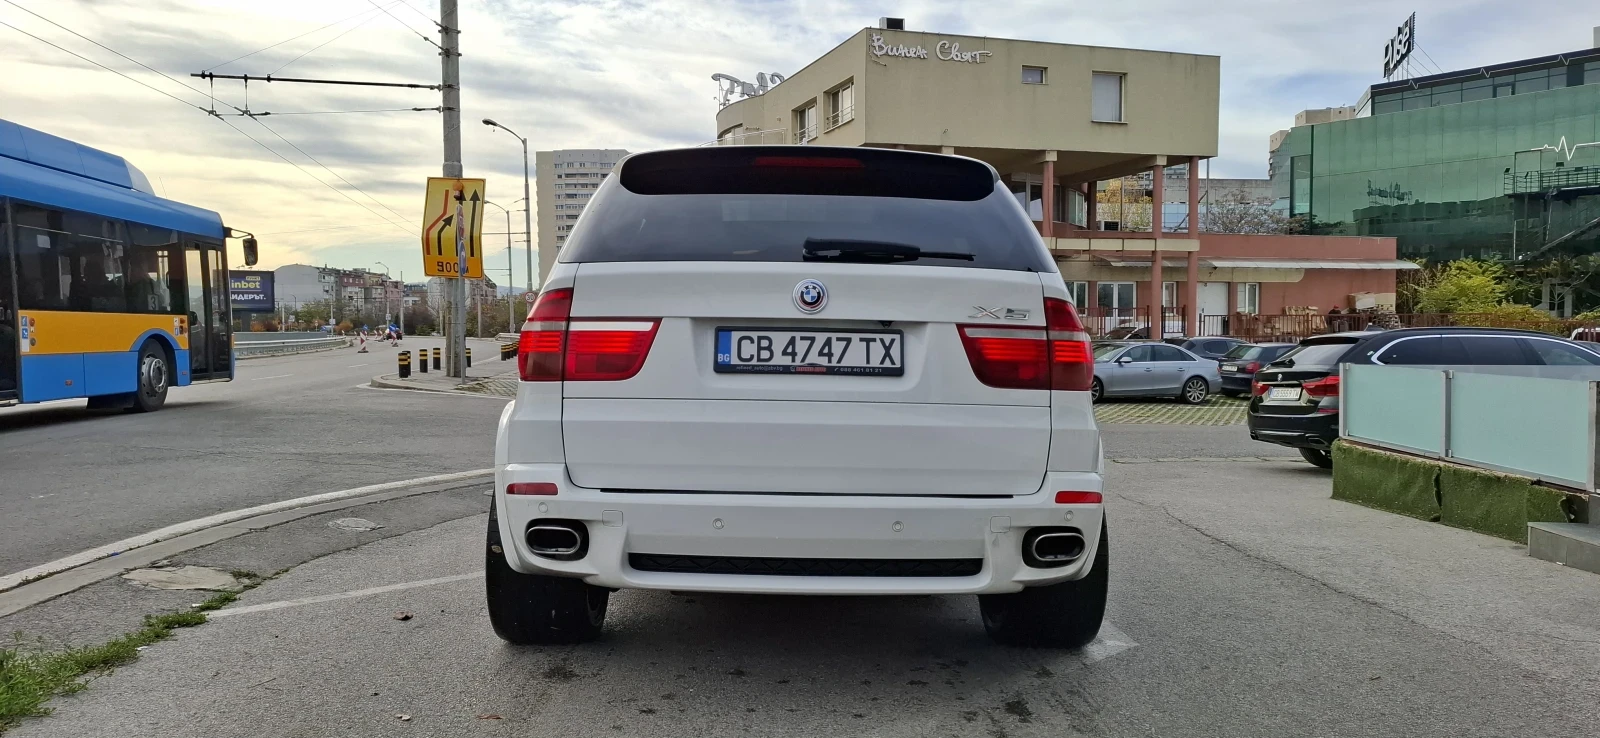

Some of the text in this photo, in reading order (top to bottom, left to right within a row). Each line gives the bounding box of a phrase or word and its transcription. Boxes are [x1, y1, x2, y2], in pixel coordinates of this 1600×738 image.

[1384, 26, 1411, 77] Pulse
[231, 279, 261, 289] inbet
[230, 293, 267, 301] ИДЕРЪТ.
[967, 305, 1031, 320] X5
[736, 335, 897, 365] CB 4747 TX
[717, 353, 731, 362] BG
